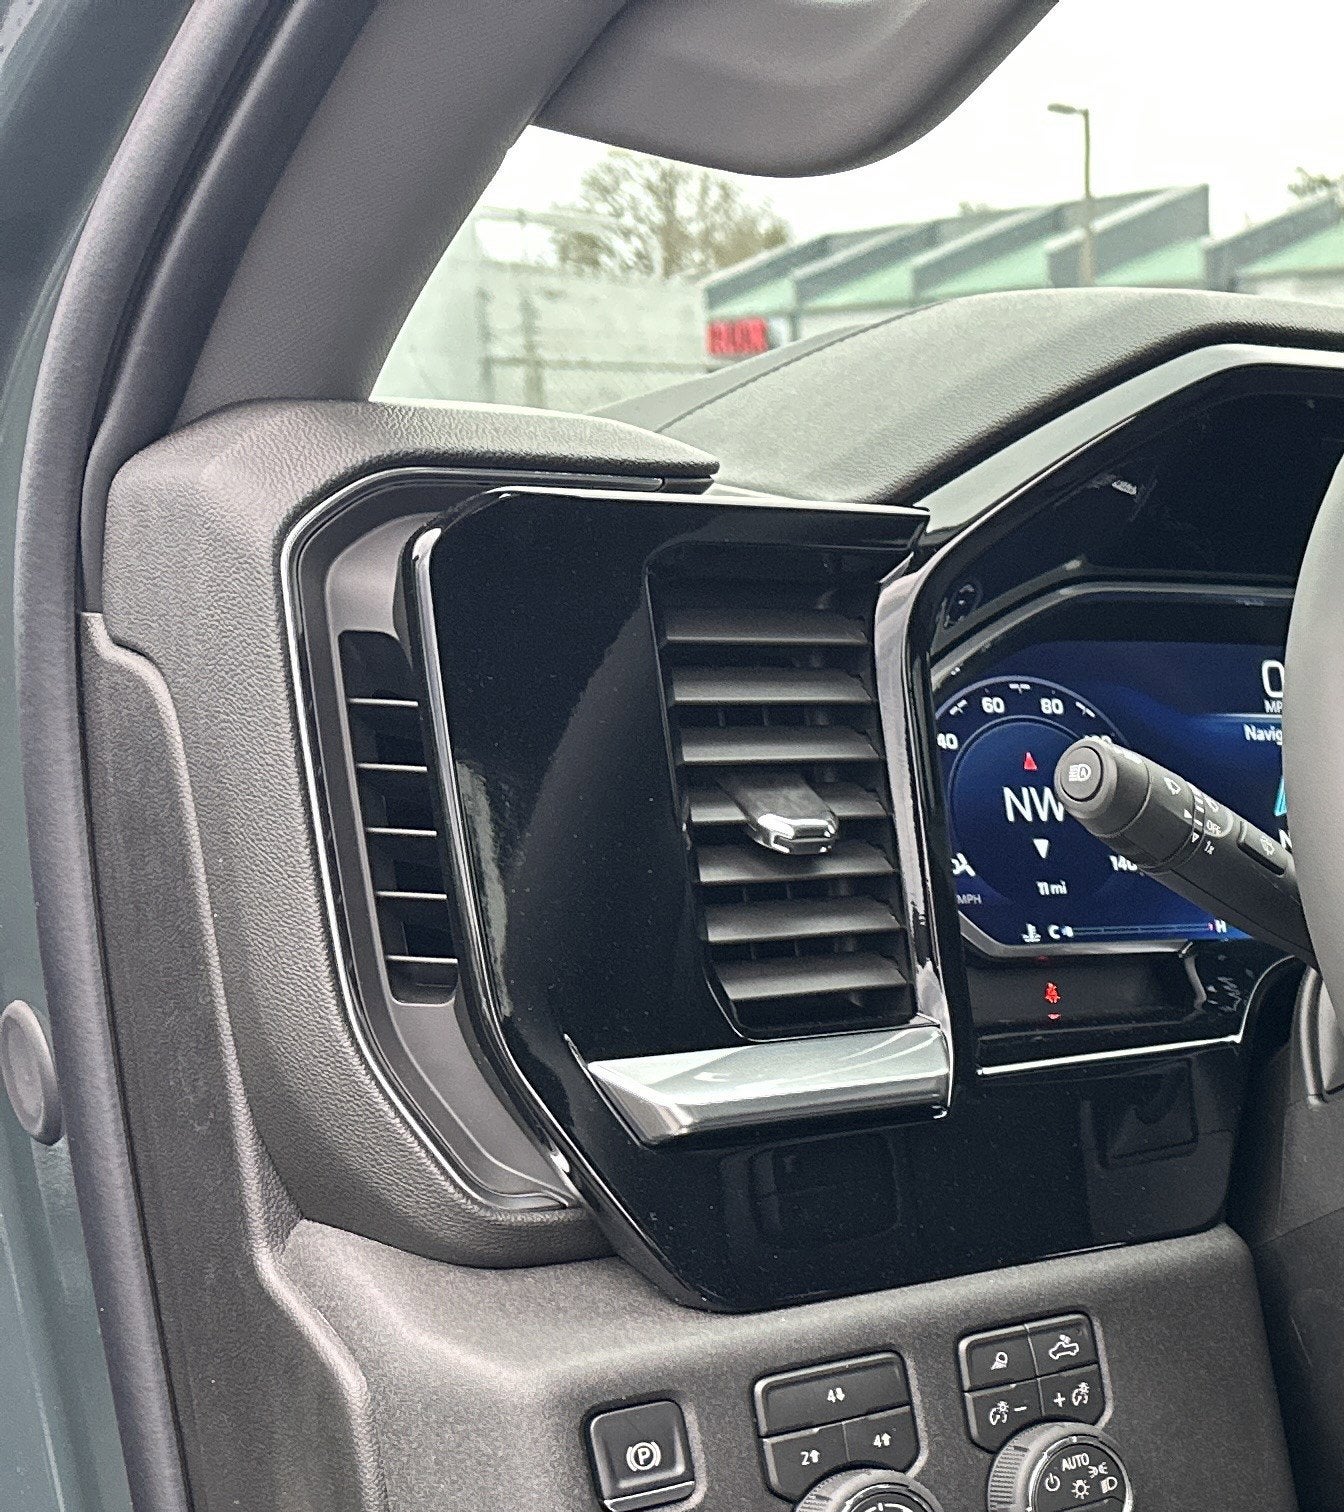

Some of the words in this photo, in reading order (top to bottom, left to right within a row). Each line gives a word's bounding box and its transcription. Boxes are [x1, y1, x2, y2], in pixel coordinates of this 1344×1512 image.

[981, 697, 1005, 714] 60
[1040, 698, 1064, 714] 80
[1264, 699, 1283, 713] MP
[936, 733, 959, 750] 40
[1002, 786, 1065, 822] NW
[1205, 819, 1222, 836] OFF
[1050, 879, 1067, 895] mi
[956, 893, 982, 905] MPH
[1048, 924, 1061, 939] C
[1214, 919, 1226, 933] H
[873, 1434, 883, 1448] 4
[800, 1451, 810, 1466] 2
[1061, 1452, 1090, 1472] AUTO
